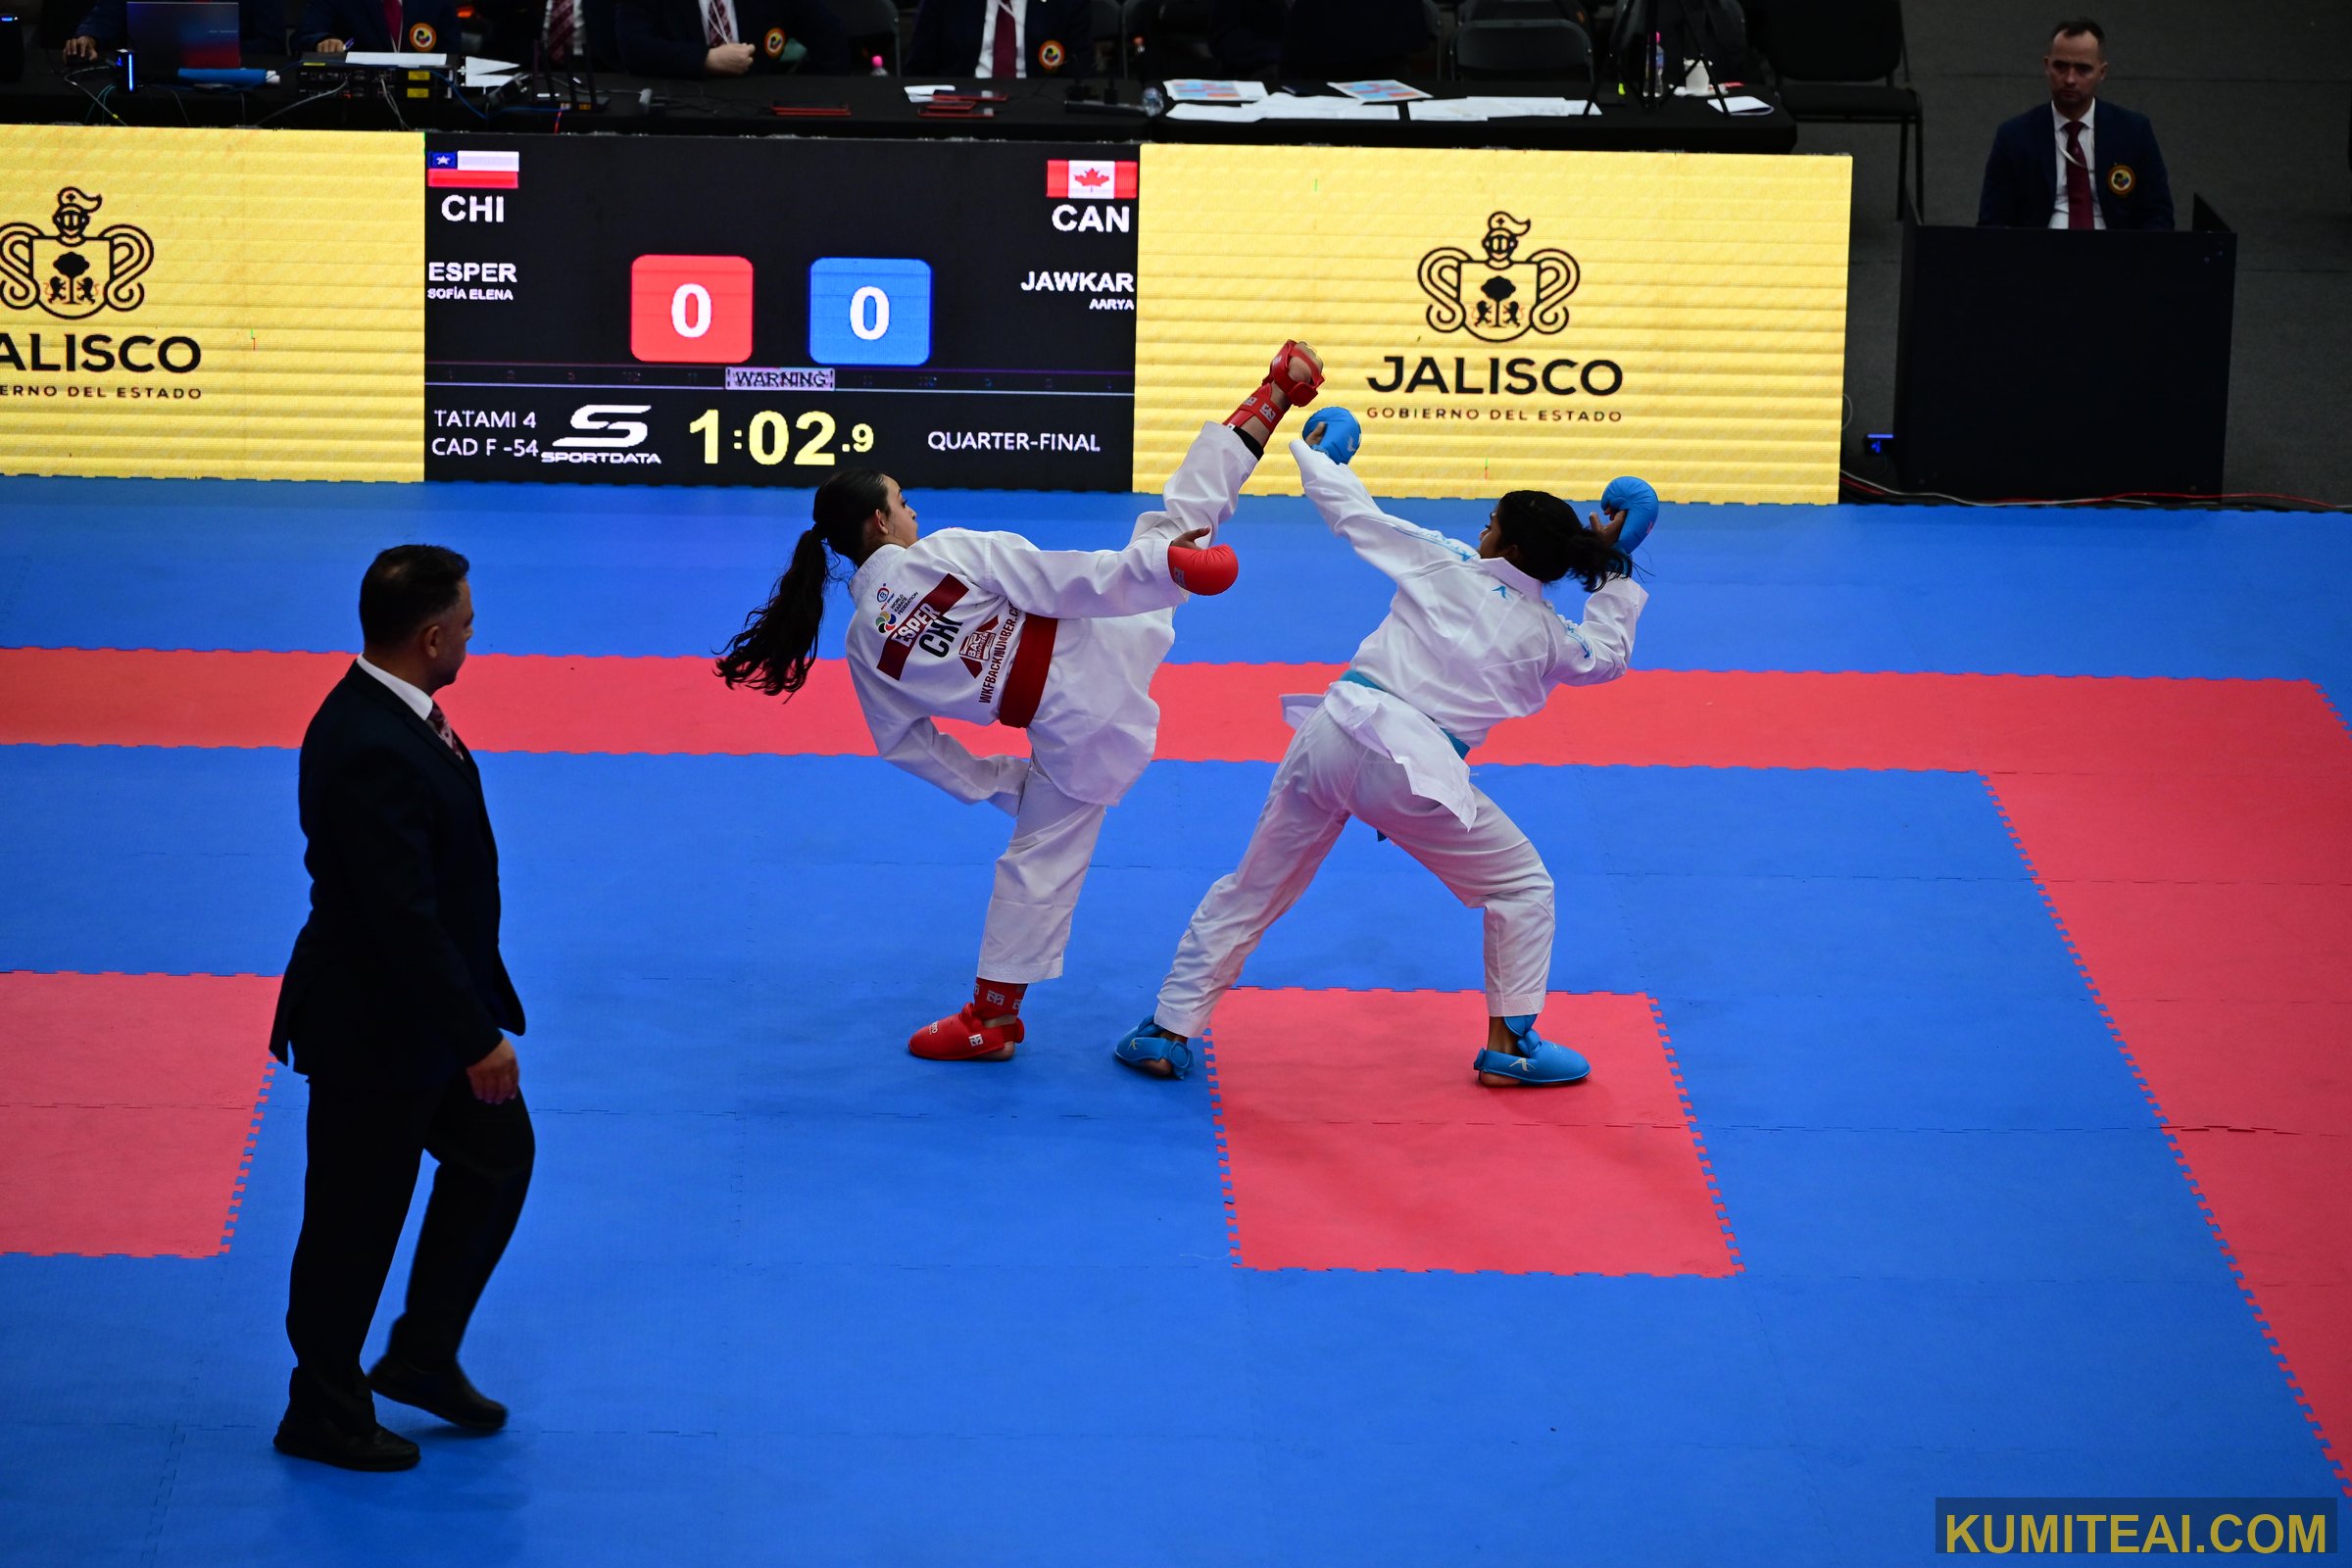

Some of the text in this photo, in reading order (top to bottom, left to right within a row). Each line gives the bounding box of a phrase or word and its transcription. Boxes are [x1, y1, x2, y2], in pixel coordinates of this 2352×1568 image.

[442, 194, 504, 222] CHI
[1052, 204, 1130, 232] CAN
[428, 262, 517, 282] ESPER
[1020, 271, 1134, 292] JAWKAR
[469, 289, 514, 300] ELENA
[1089, 298, 1134, 310] AARYA
[669, 282, 712, 338] 0
[849, 285, 891, 340] 0
[735, 370, 826, 388] WARNING
[1366, 356, 1623, 396] JALISCO
[68, 386, 106, 397] DEL
[117, 387, 202, 399] ESTADO
[434, 410, 537, 428] TATAMI 4
[1366, 407, 1622, 422] GOBIERNO DEL ESTADO
[431, 438, 539, 457] CAD F -54
[927, 431, 1101, 452] QUARTER-FINAL
[541, 452, 662, 465] SPORTDATA
[891, 602, 941, 648] ESPER
[919, 613, 963, 659] CHI
[967, 632, 981, 658] BAC
